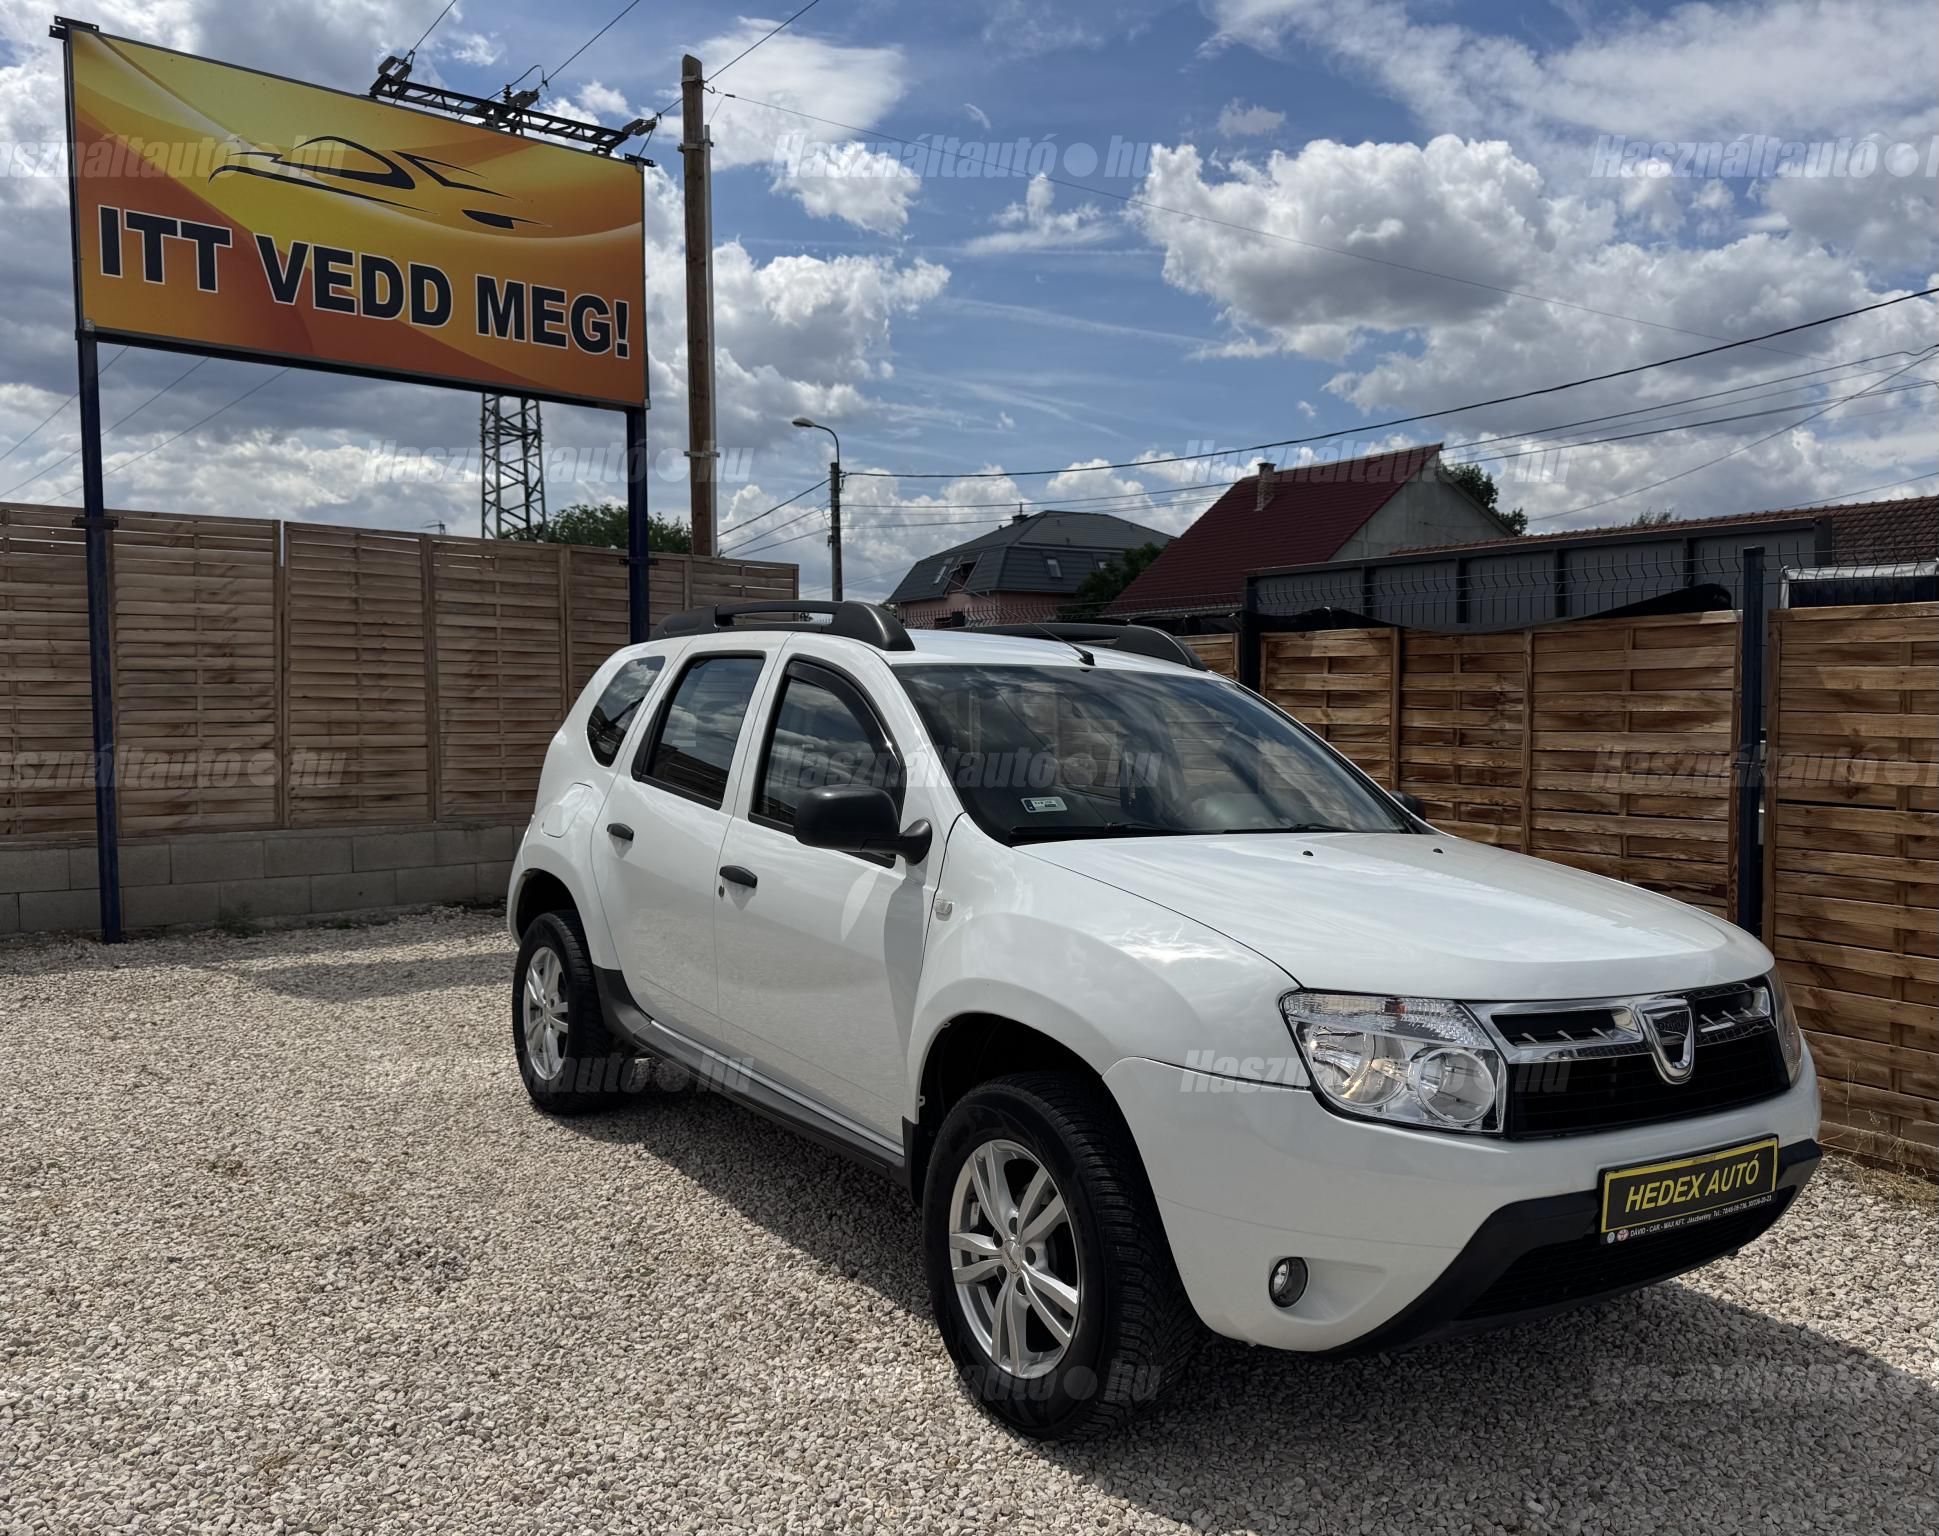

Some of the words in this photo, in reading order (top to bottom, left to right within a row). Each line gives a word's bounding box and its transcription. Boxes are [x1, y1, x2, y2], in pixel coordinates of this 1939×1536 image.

[98, 204, 233, 294] ITT
[253, 231, 453, 329] VEDD
[474, 273, 631, 360] MEG!
[1625, 1172, 1706, 1213] HEDEX
[1705, 1153, 1760, 1197] AUTÓ
